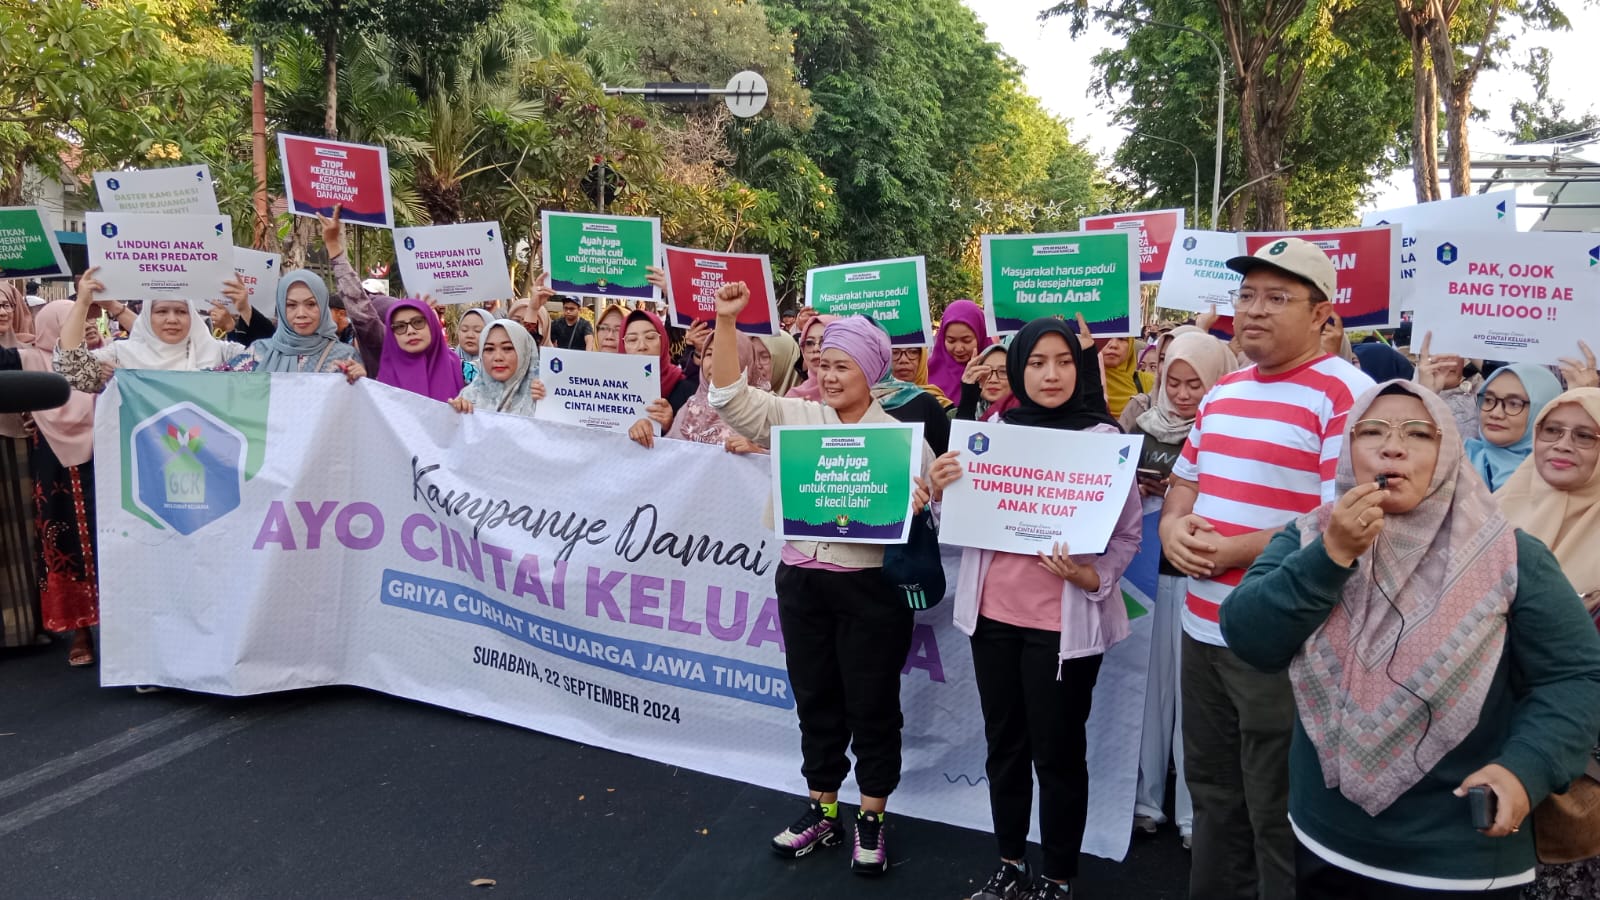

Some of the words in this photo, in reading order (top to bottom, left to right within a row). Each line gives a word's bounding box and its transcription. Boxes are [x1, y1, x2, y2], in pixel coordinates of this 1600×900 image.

[321, 160, 343, 169] STOP!
[310, 165, 356, 179] KEKERASAN
[319, 176, 348, 185] KEPADA
[311, 182, 358, 195] PEREMPUAN
[316, 191, 332, 199] DAN
[333, 193, 354, 202] ANAK
[117, 240, 170, 249] LINDUNGI
[173, 242, 205, 250] ANAK
[580, 236, 602, 246] Ayah
[602, 237, 621, 248] juga
[105, 252, 130, 260] KITA
[132, 252, 158, 260] DARI
[161, 253, 218, 261] PREDATOR
[415, 249, 465, 259] PEREMPUAN
[466, 248, 481, 256] ITU
[578, 246, 607, 256] berhak
[608, 249, 623, 257] cuti
[416, 262, 445, 270] IBUMU,
[446, 259, 483, 268] SAYANGI
[565, 255, 588, 263] untuk
[589, 256, 637, 266] menyambut
[139, 264, 187, 272] SEKSUAL
[579, 265, 586, 273] si
[586, 264, 606, 274] kecil
[606, 266, 624, 275] lahir
[1001, 266, 1054, 278] Masyarakat
[1055, 266, 1083, 275] harus
[1084, 263, 1116, 276] peduli
[1468, 262, 1504, 279] PAK,
[1508, 263, 1555, 279] OJOK
[433, 270, 469, 280] MEREKA
[701, 271, 723, 281] STOP!
[1013, 279, 1035, 290] pada
[1036, 277, 1104, 289] kesejahteraan
[819, 291, 862, 303] Masyarakat
[862, 289, 884, 298] harus
[885, 286, 909, 296] peduli
[1016, 291, 1036, 303] Ibu
[1038, 291, 1063, 303] dan
[1064, 289, 1101, 303] Anak
[1448, 281, 1495, 297] BANG
[1499, 284, 1547, 300] TOYIB
[1551, 287, 1574, 301] AE
[698, 304, 714, 312] DAN
[829, 304, 848, 312] pada
[848, 299, 900, 311] kesejahteraan
[1460, 302, 1543, 320] MULIOOO
[1546, 307, 1557, 321] !!
[872, 309, 899, 320] Anak
[568, 376, 601, 386] SEMUA
[602, 379, 629, 389] ANAK
[554, 388, 592, 398] ADALAH
[593, 391, 620, 401] ANAK
[621, 394, 646, 404] KITA,
[564, 401, 595, 412] CINTAI
[597, 404, 636, 415] MEREKA
[817, 455, 844, 469] Ayah
[844, 454, 868, 469] juga
[814, 469, 849, 482] berhak
[850, 469, 871, 482] cuti
[967, 461, 1065, 484] LINGKUNGAN
[1068, 472, 1113, 488] SEHAT,
[169, 471, 201, 496] GCK
[799, 482, 826, 493] untuk
[827, 482, 888, 497] menyambut
[972, 478, 1034, 496] TUMBUH
[1036, 486, 1105, 502] KEMBANG
[815, 497, 824, 508] si
[824, 496, 847, 508] kecil
[848, 496, 871, 508] lahir
[997, 498, 1038, 514] ANAK
[1041, 504, 1078, 518] KUAT
[411, 455, 611, 568] Kampanye
[615, 503, 772, 576] Damai
[252, 500, 385, 551] AYO
[400, 513, 569, 611] CINTAI
[585, 566, 946, 684] KELUAA
[388, 579, 449, 609] GRIYA
[453, 593, 524, 634] CURHAT
[527, 622, 637, 670] KELUARGA
[641, 652, 706, 683] JAWA
[712, 665, 787, 700] TIMUR
[473, 645, 543, 683] SURABAYA,
[544, 667, 561, 688] 22
[562, 674, 639, 714] SEPTEMBER
[643, 699, 681, 724] 2024
